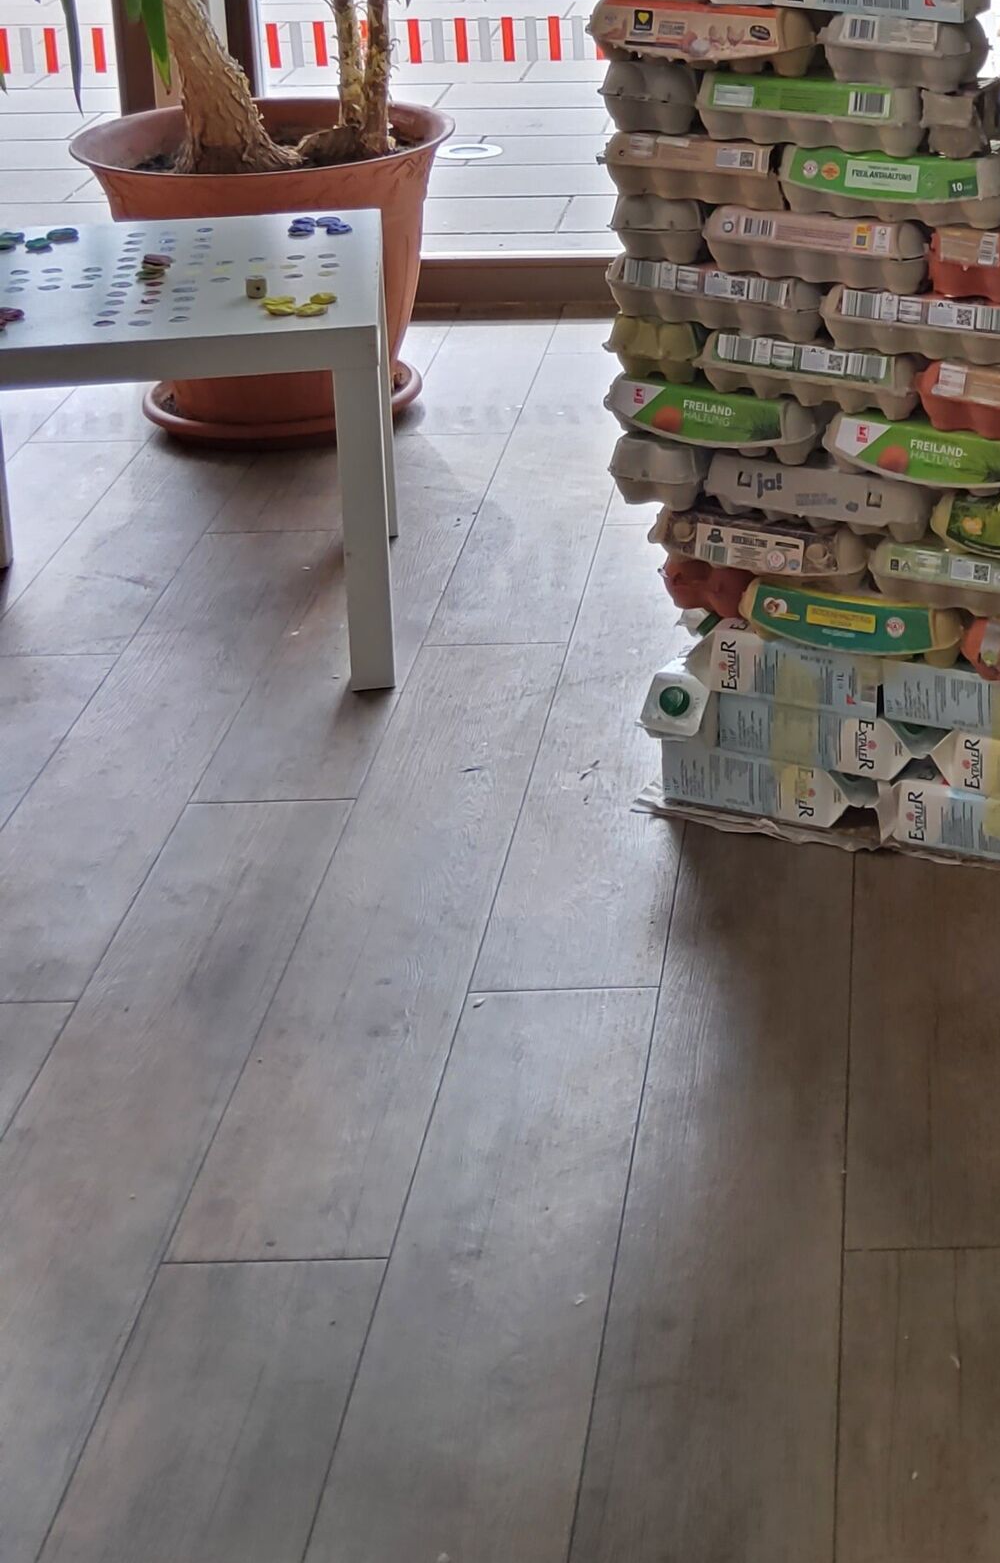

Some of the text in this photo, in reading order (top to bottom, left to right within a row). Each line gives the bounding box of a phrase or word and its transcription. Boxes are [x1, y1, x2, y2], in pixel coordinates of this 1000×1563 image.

[951, 182, 963, 192] 10
[683, 399, 736, 417] FREILAND-
[683, 410, 730, 427] HALTUNG
[910, 439, 968, 457] FREILAND-
[910, 450, 961, 469] HALTUNG
[756, 472, 783, 499] ja!
[720, 640, 738, 691] EXTALER
[858, 719, 875, 771] EXTALER
[964, 738, 981, 790] EXTALER
[907, 791, 925, 842] EXTALER
